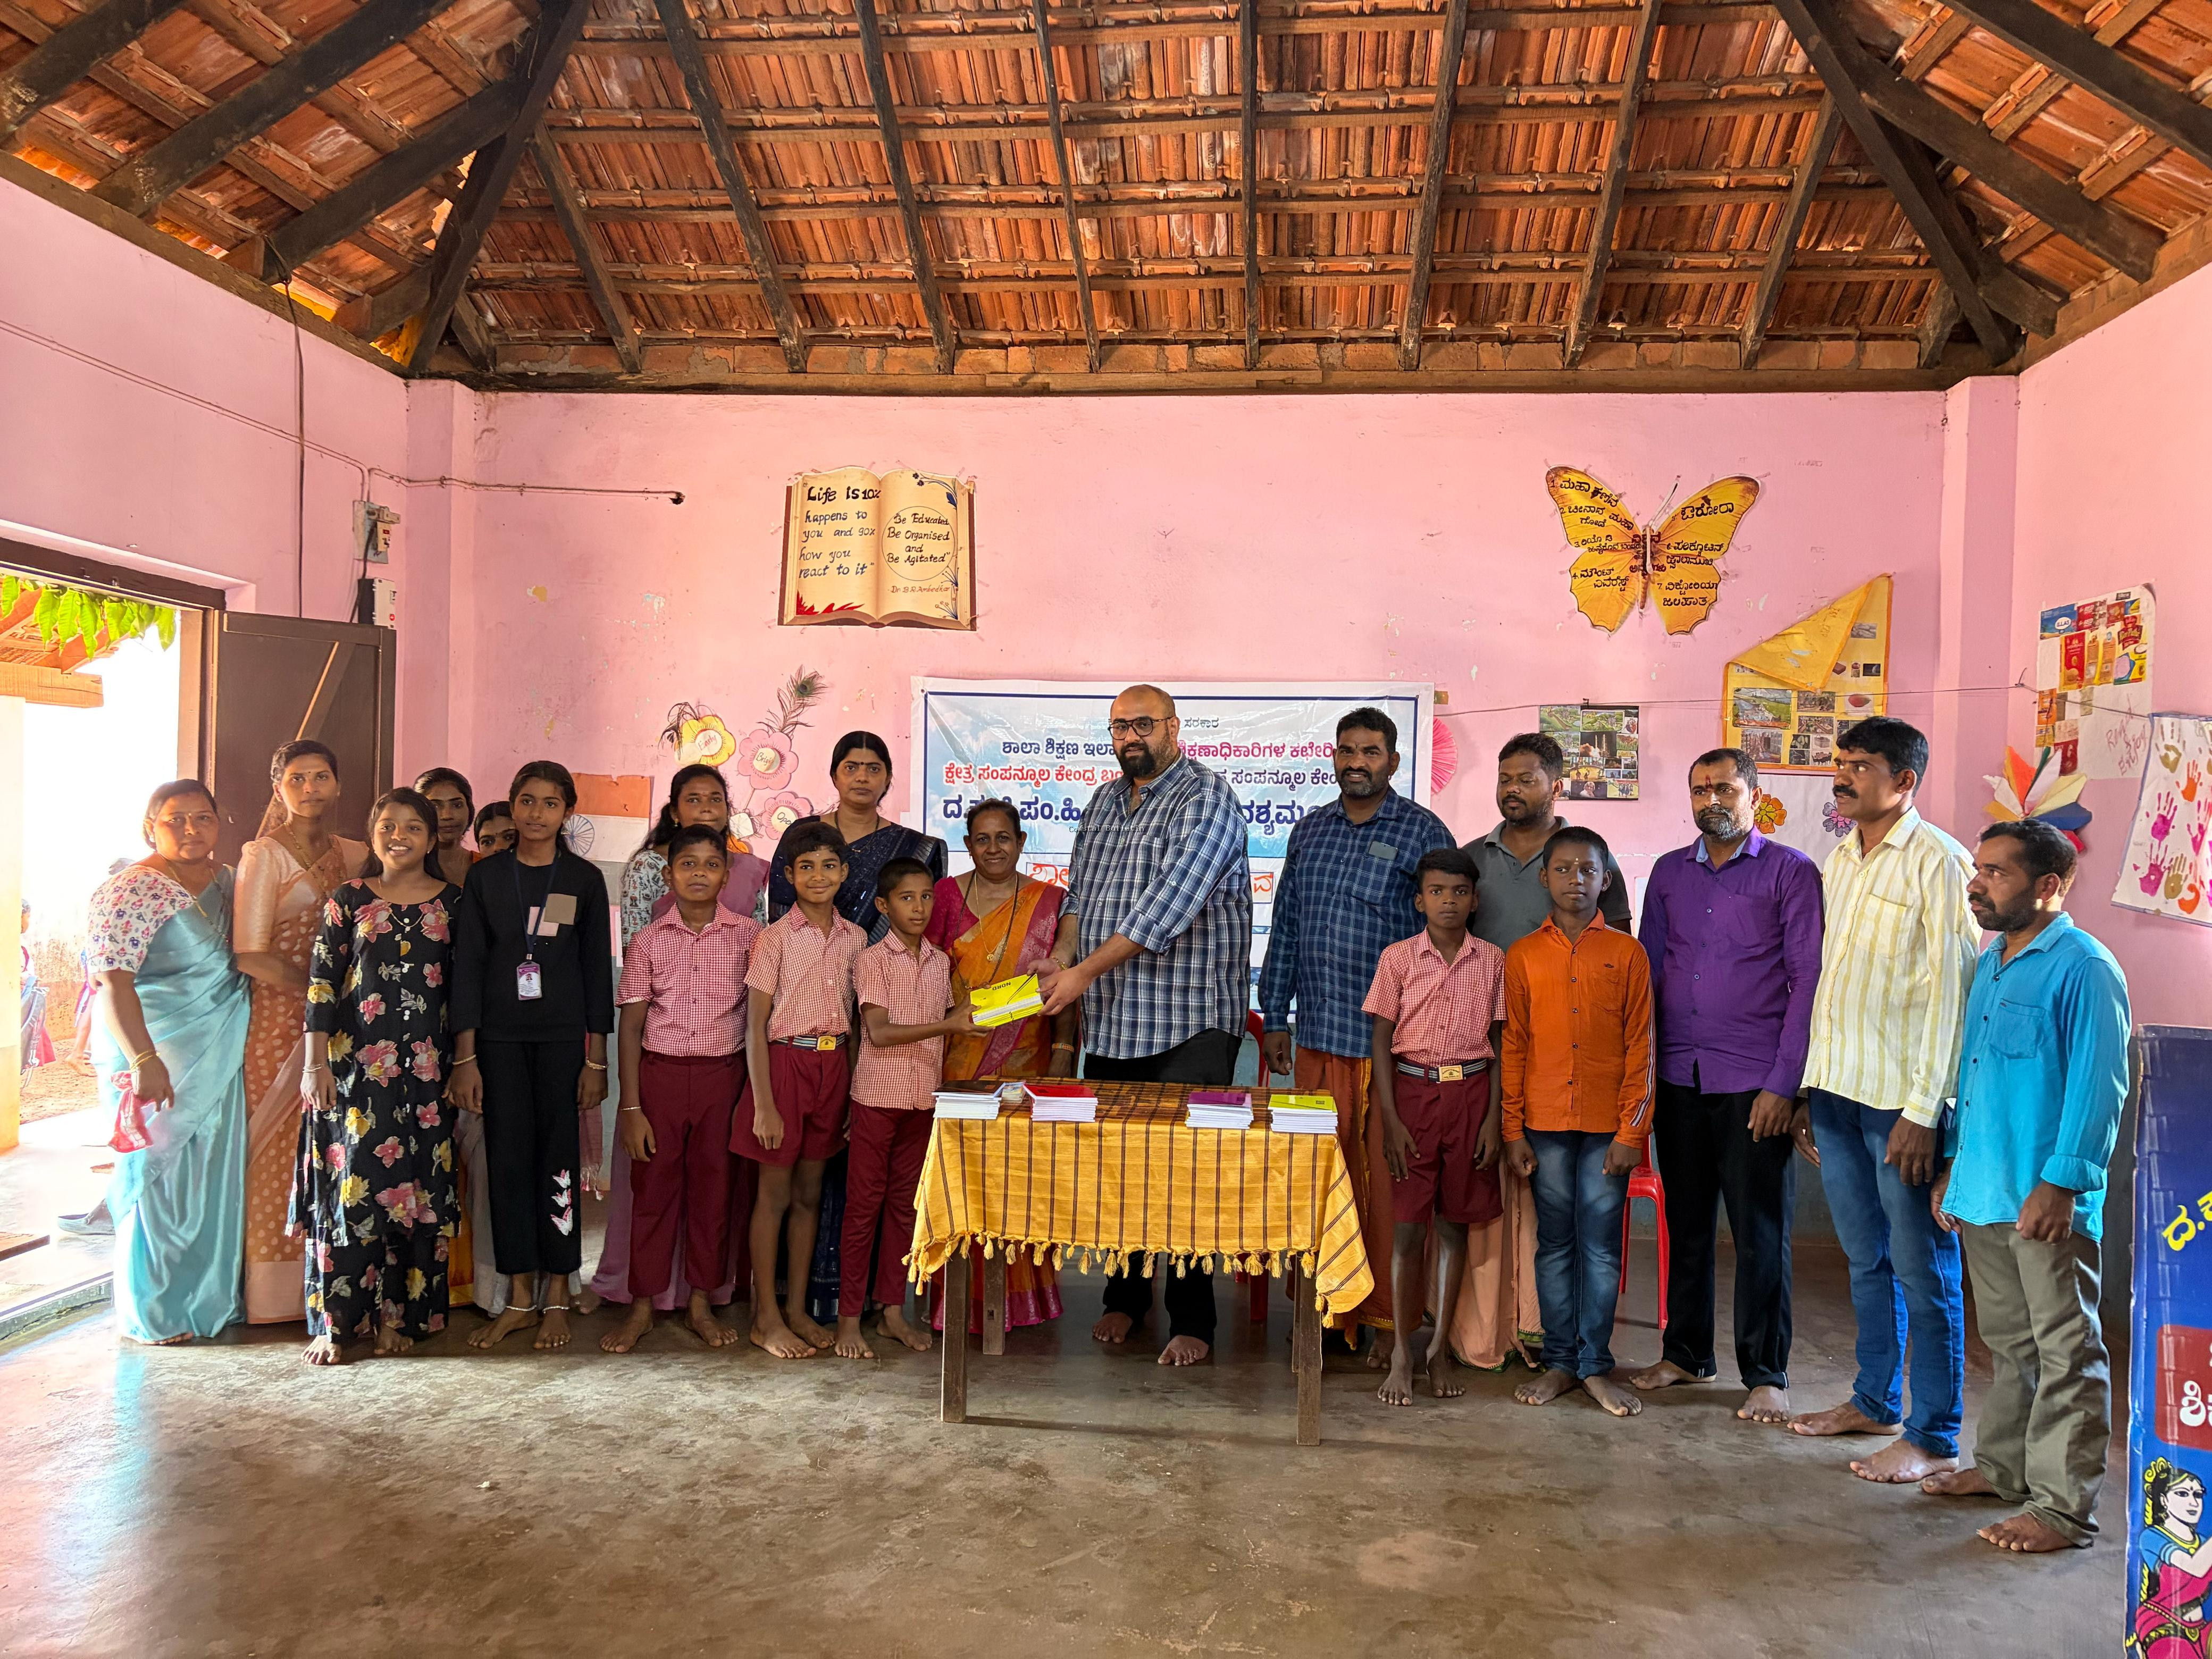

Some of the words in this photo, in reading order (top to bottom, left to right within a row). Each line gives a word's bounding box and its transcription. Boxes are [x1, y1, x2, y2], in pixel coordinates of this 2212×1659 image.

[1560, 478, 1591, 492] ಮಹಾ
[861, 488, 882, 500] 10%
[805, 510, 848, 525] happens
[856, 510, 867, 520] to
[911, 513, 950, 525] Educated
[1568, 505, 1606, 515] ಚೀನಾದ
[1608, 513, 1635, 531] ಮಹಾ
[1579, 516, 1607, 527] ಗೋಡೆ
[801, 530, 823, 543] you
[834, 527, 853, 537] and
[858, 527, 876, 537] 90%
[887, 526, 901, 538] Be
[905, 530, 950, 541] Organised
[799, 546, 823, 561] how
[829, 550, 851, 564] you
[905, 544, 924, 552] and
[886, 552, 900, 563] Be
[799, 564, 830, 579] react
[836, 564, 850, 575] to
[1665, 580, 1717, 595] ವಿಕ್ಟೋರಿಯಾ
[1663, 597, 1708, 606] ಜಲಪಾತ
[1184, 717, 1219, 728] ಸರಕಾರ
[1002, 741, 1041, 754] ಶಾಲಾ
[1045, 738, 1079, 760] ಶಿಕ್ಷಣ
[1083, 740, 1116, 756] ಇಲಾ
[945, 762, 974, 784] ಕ್ಷೇತ್ರ
[978, 765, 1051, 787] ಸಂಪನ್ಮೂಲ
[1055, 765, 1097, 786] ಕೇಂದ್ರ
[1231, 769, 1306, 791] ಸಂಪನ್ಮೂಲ
[1310, 768, 1337, 785] ಕೇಂ
[777, 812, 792, 825] Ope
